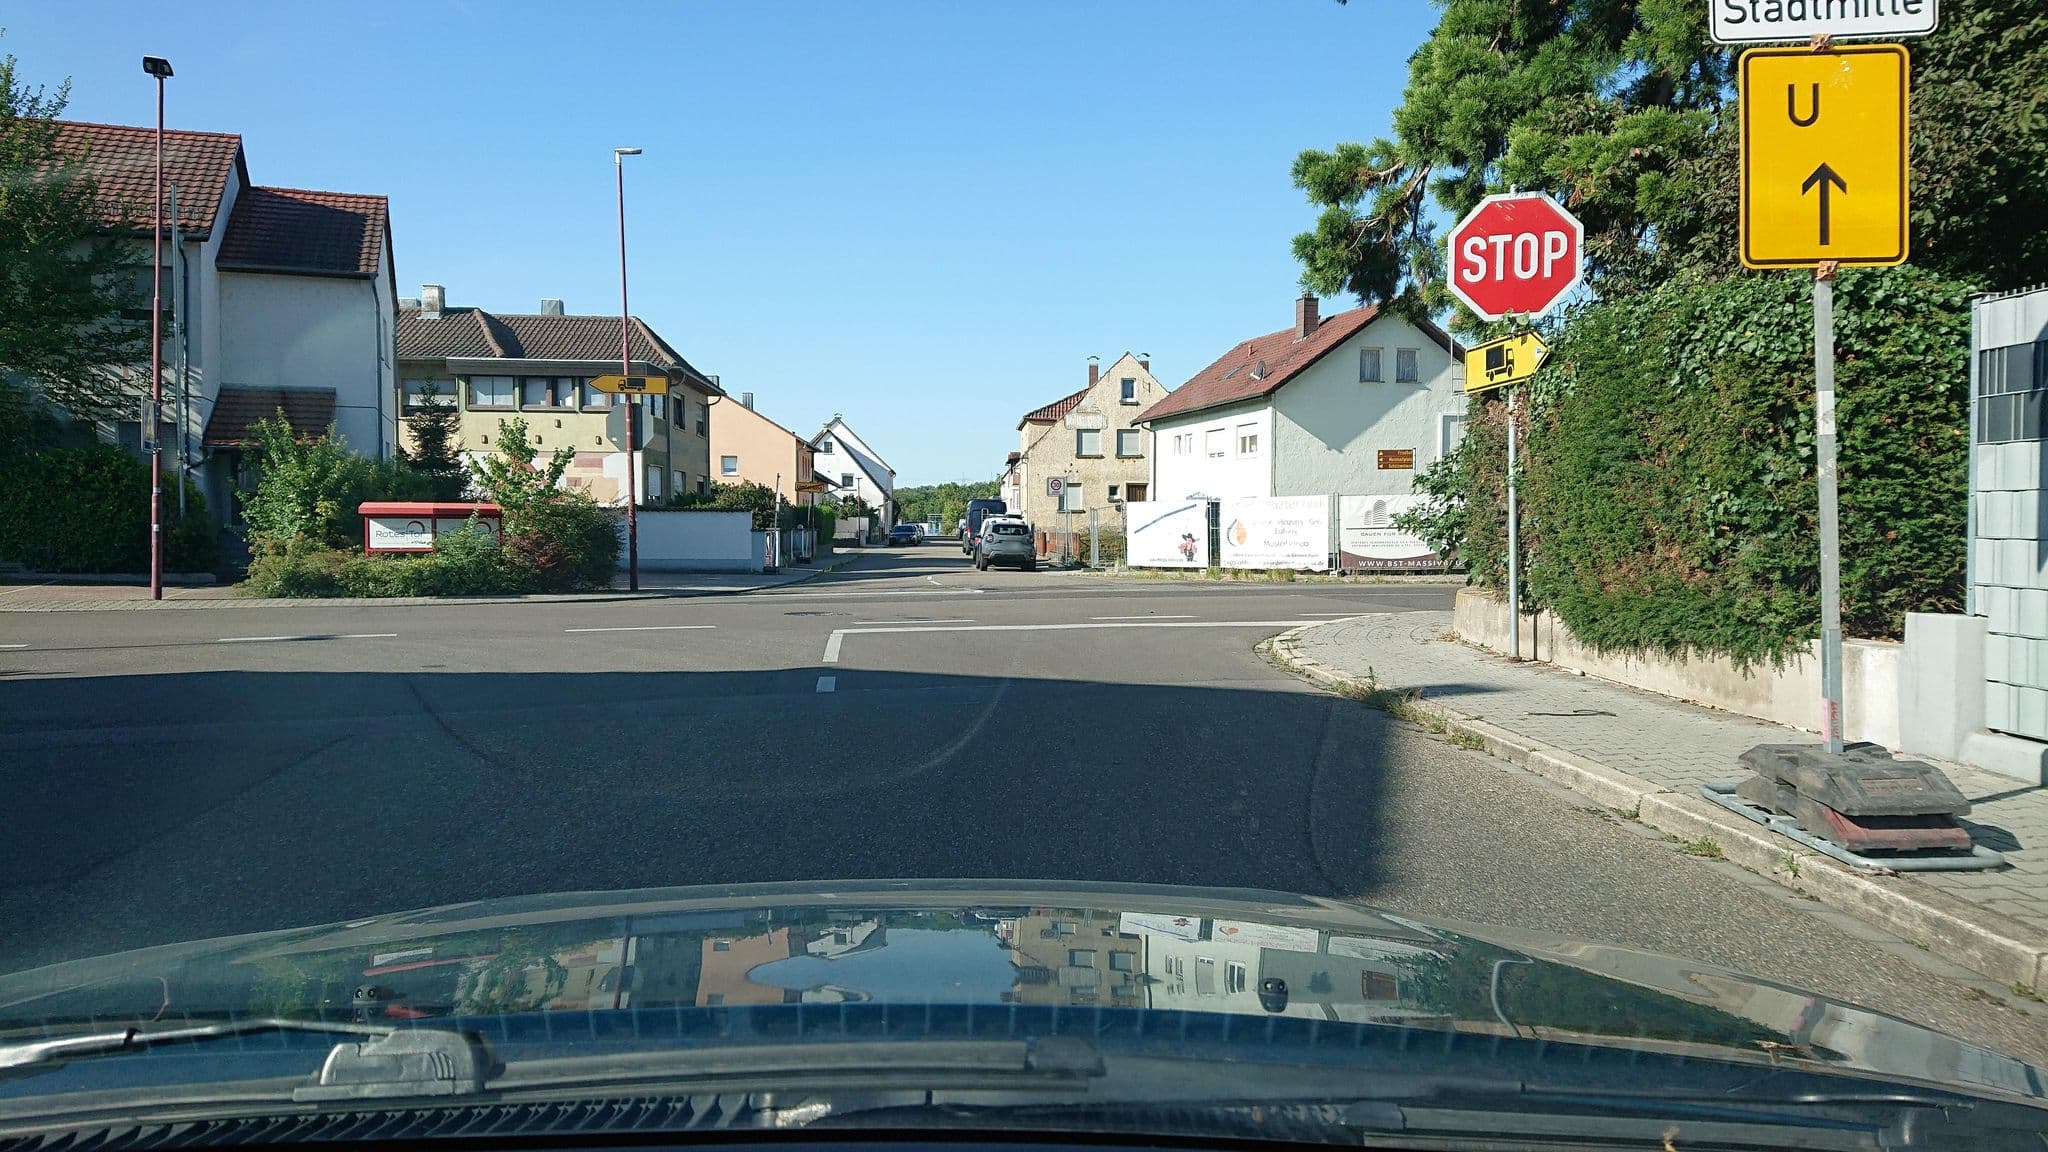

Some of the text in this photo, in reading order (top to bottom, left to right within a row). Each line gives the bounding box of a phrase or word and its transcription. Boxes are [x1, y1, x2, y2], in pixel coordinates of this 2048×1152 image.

[1787, 83, 1820, 127] U
[1462, 230, 1568, 283] STOP
[375, 530, 423, 538] Rotes Tor
